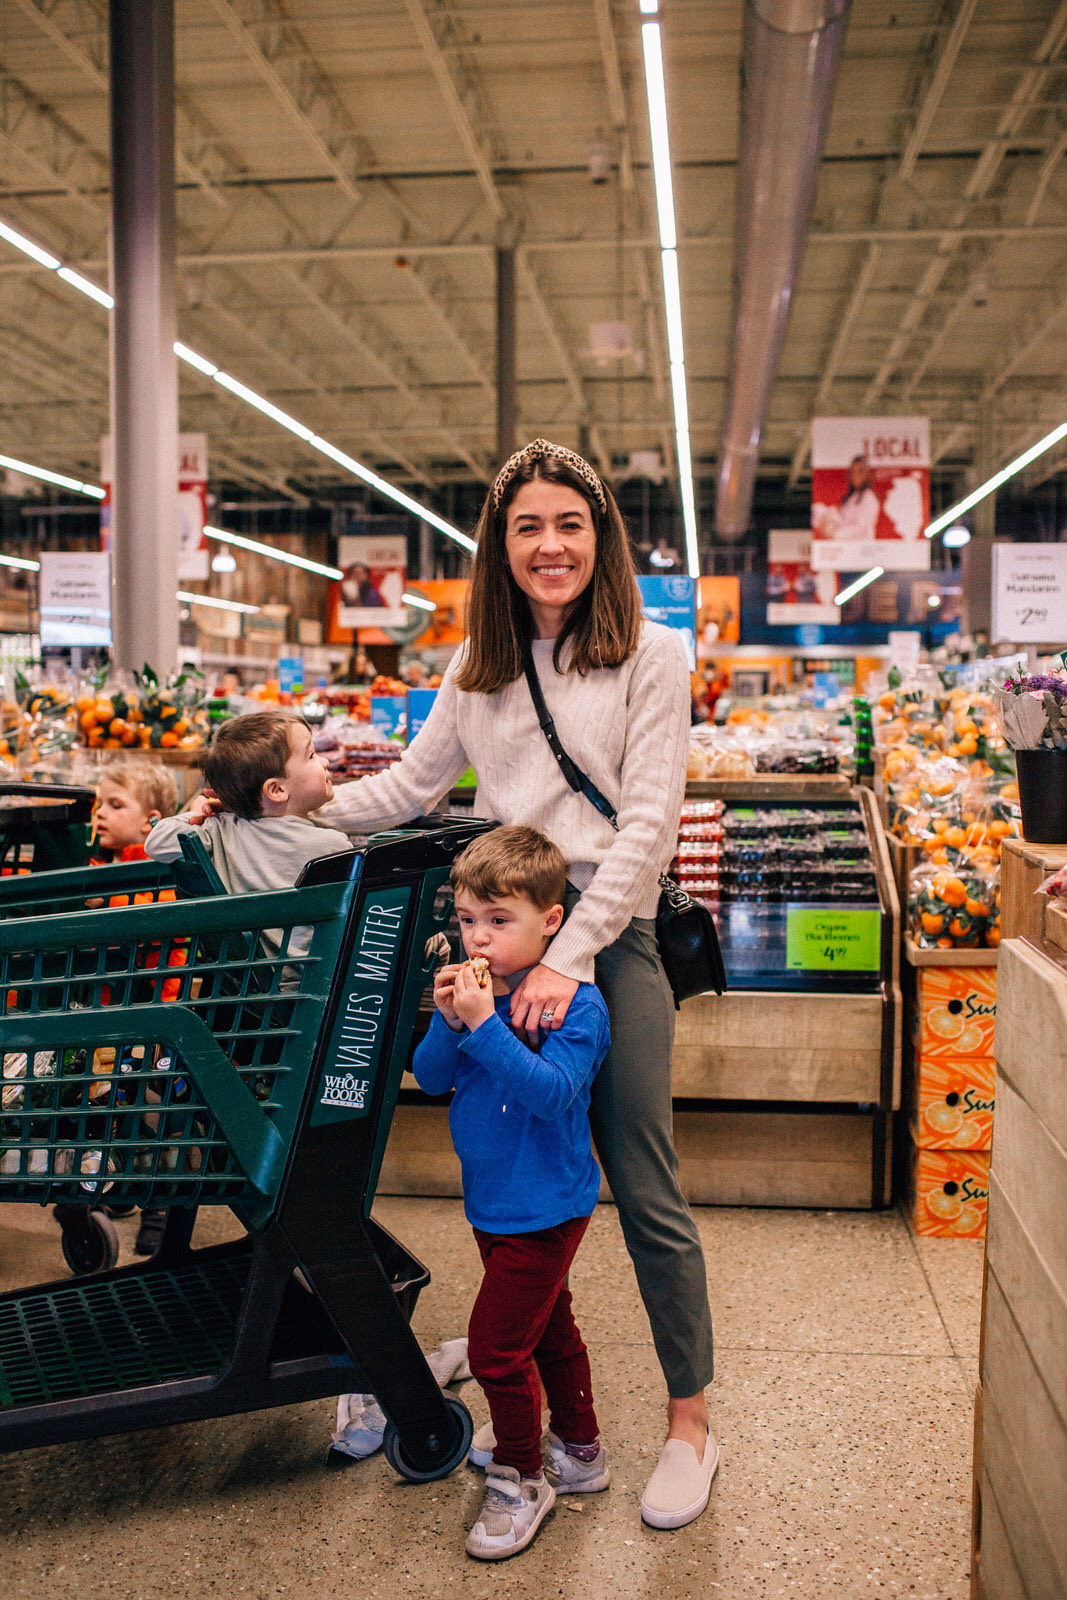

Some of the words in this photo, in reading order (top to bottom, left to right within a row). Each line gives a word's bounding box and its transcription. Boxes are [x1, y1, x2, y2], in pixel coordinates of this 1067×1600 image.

[862, 436, 920, 459] LOCAL
[354, 905, 404, 982] MATTER
[335, 993, 384, 1068] VALUES
[324, 1073, 370, 1092] WHOLE
[323, 1087, 365, 1103] FOODS
